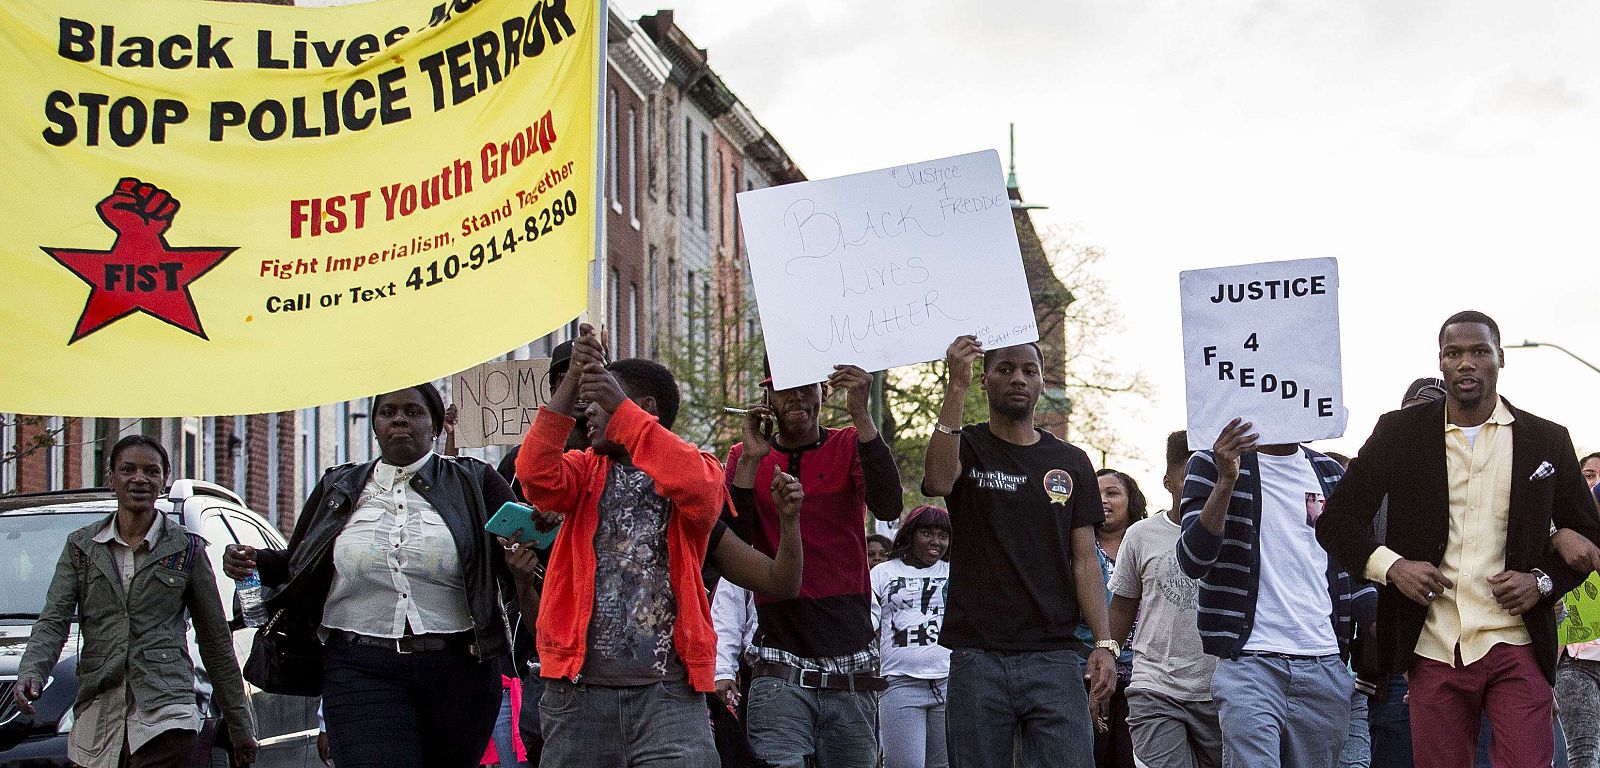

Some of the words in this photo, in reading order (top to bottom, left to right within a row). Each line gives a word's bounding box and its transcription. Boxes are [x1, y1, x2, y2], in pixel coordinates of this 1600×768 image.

[42, 90, 188, 147] STOP
[209, 66, 412, 142] POLICE
[418, 0, 577, 112] TERROR
[58, 17, 234, 69] Black
[290, 191, 371, 239] FIST
[380, 159, 473, 221] Youth
[480, 109, 557, 184] Group
[260, 257, 318, 280] Fight
[325, 230, 455, 273] Imperialism,
[461, 200, 513, 237] Stand
[515, 160, 575, 209] Together
[784, 198, 945, 276] BLACK
[939, 193, 1004, 220] FREDDIE
[104, 262, 183, 292] FIST
[266, 293, 311, 314] Call
[320, 292, 342, 308] or
[349, 281, 397, 303] Text
[405, 190, 577, 291] 410-914-8280
[1210, 275, 1326, 304] JUSTICE
[1243, 332, 1259, 352] 4
[460, 370, 511, 408] NO
[1203, 346, 1333, 417] FREDDIE
